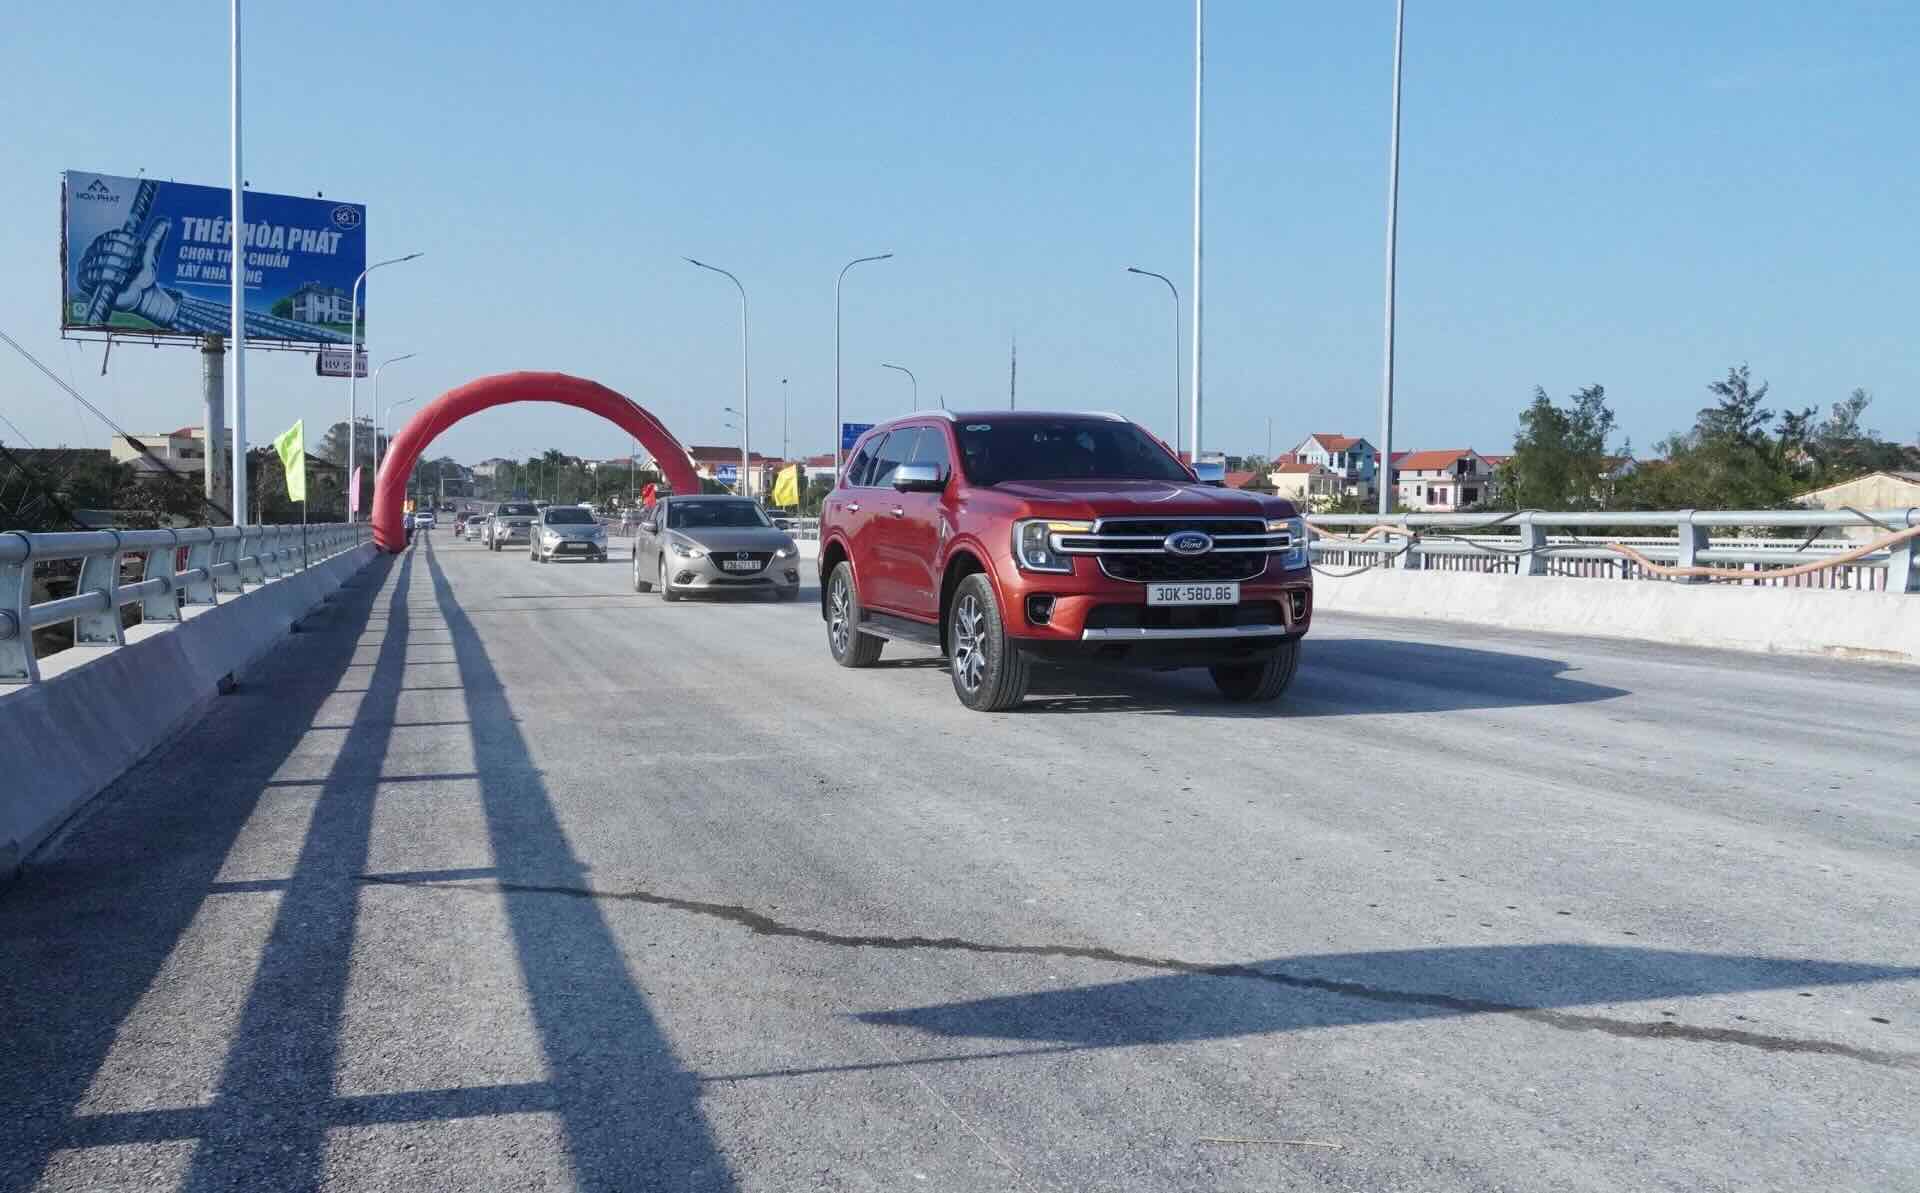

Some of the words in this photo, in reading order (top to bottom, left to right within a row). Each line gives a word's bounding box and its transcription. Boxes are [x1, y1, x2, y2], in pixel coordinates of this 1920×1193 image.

[288, 228, 343, 255] PHÁT
[179, 246, 214, 265] CHỌN
[176, 263, 199, 278] XÂY
[1179, 538, 1203, 549] Ford
[1156, 587, 1232, 601] 30K-580.86
